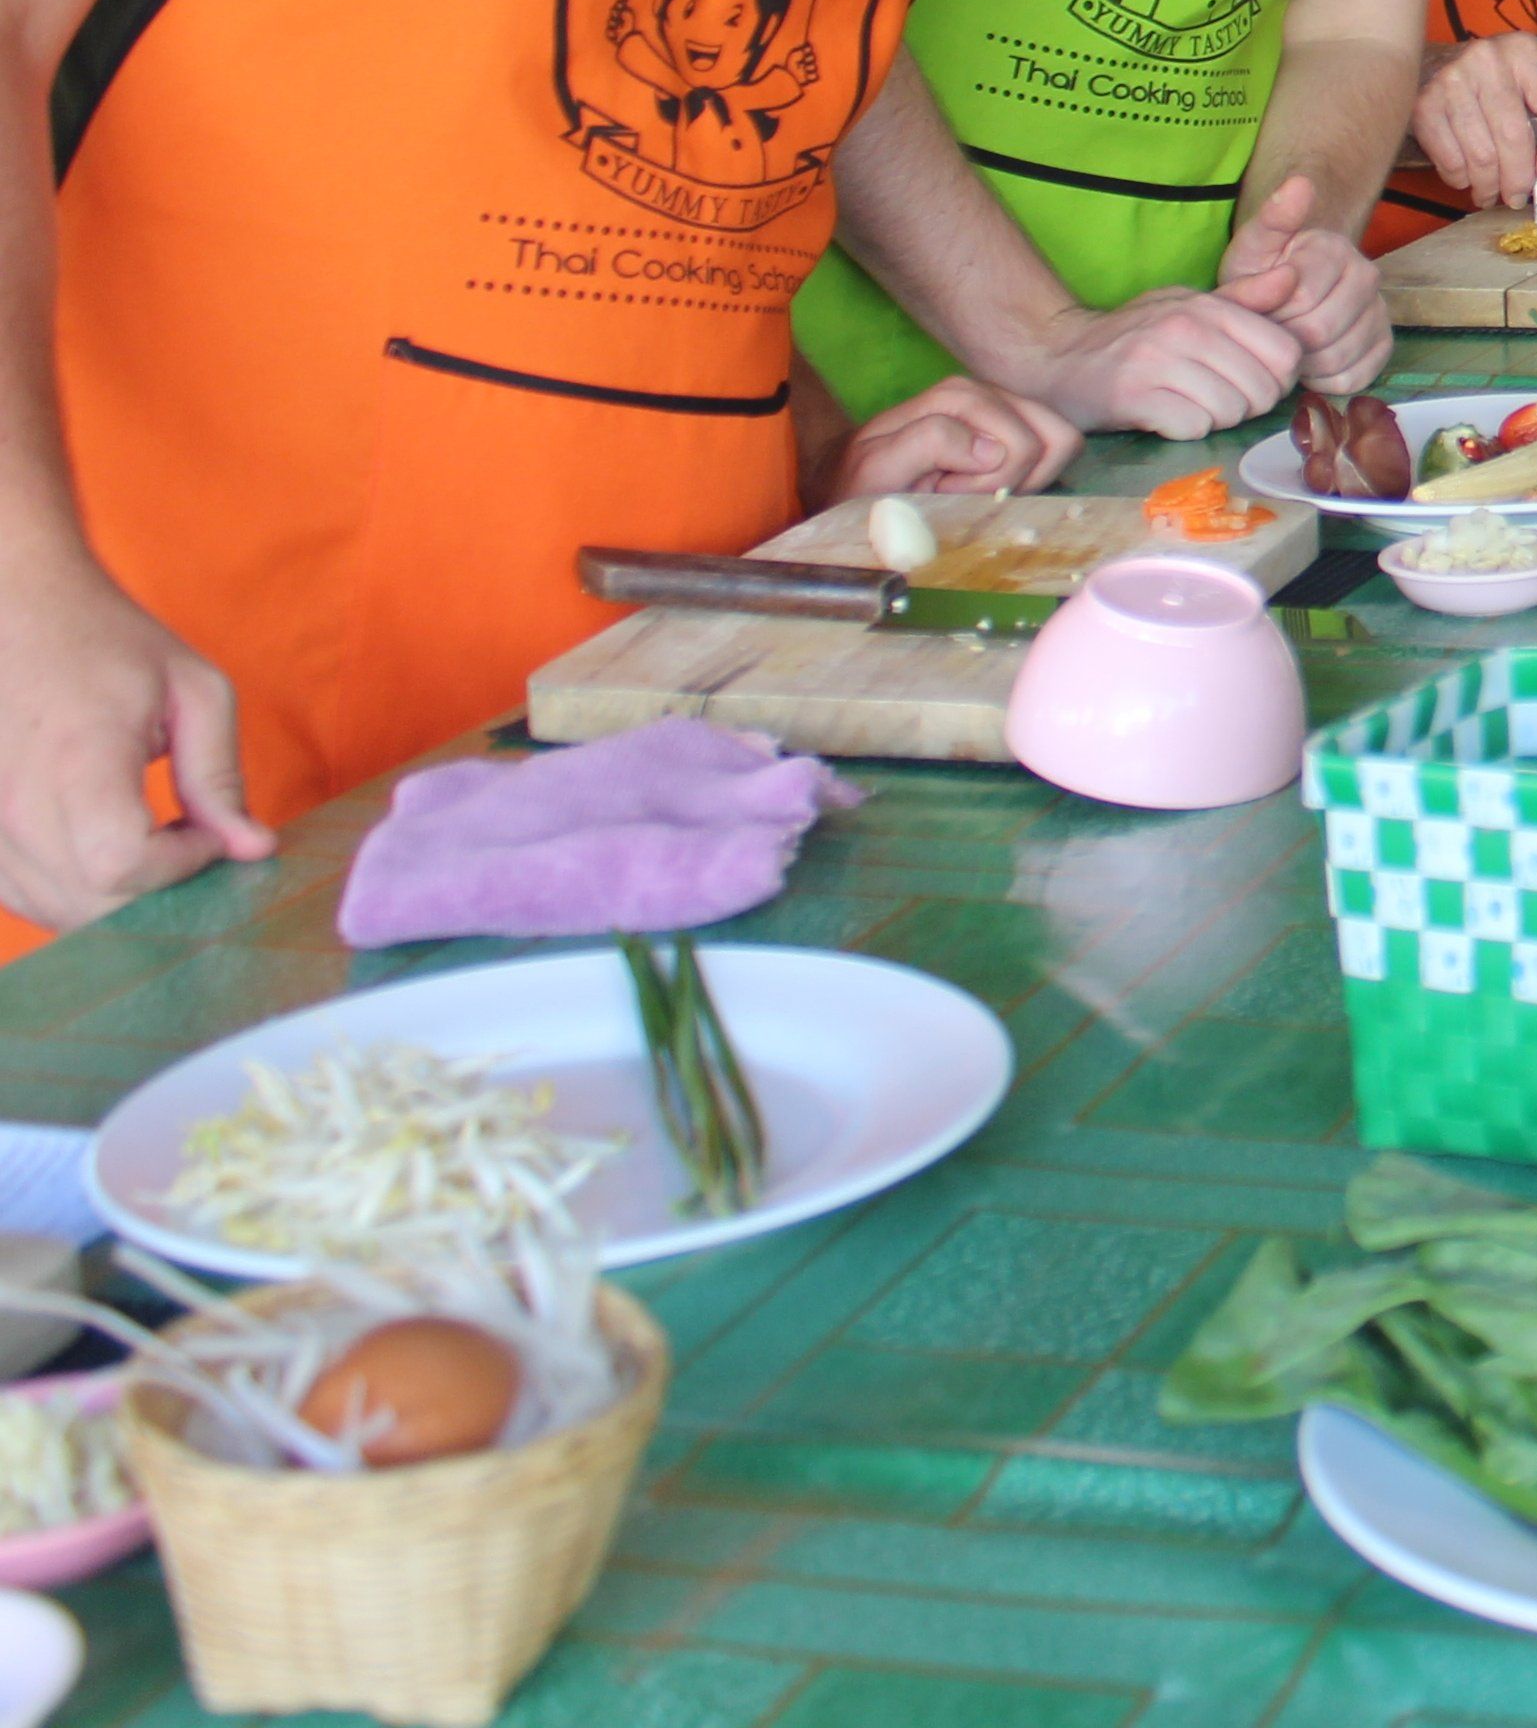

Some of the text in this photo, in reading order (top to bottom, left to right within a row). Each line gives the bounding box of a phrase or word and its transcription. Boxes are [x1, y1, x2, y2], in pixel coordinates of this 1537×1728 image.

[1092, 0, 1243, 57] YUMMY TASTY
[1009, 55, 1247, 112] Thai Cooking School
[608, 154, 728, 224] YUMMY
[508, 237, 599, 276] Thai
[611, 248, 743, 296] Cooking
